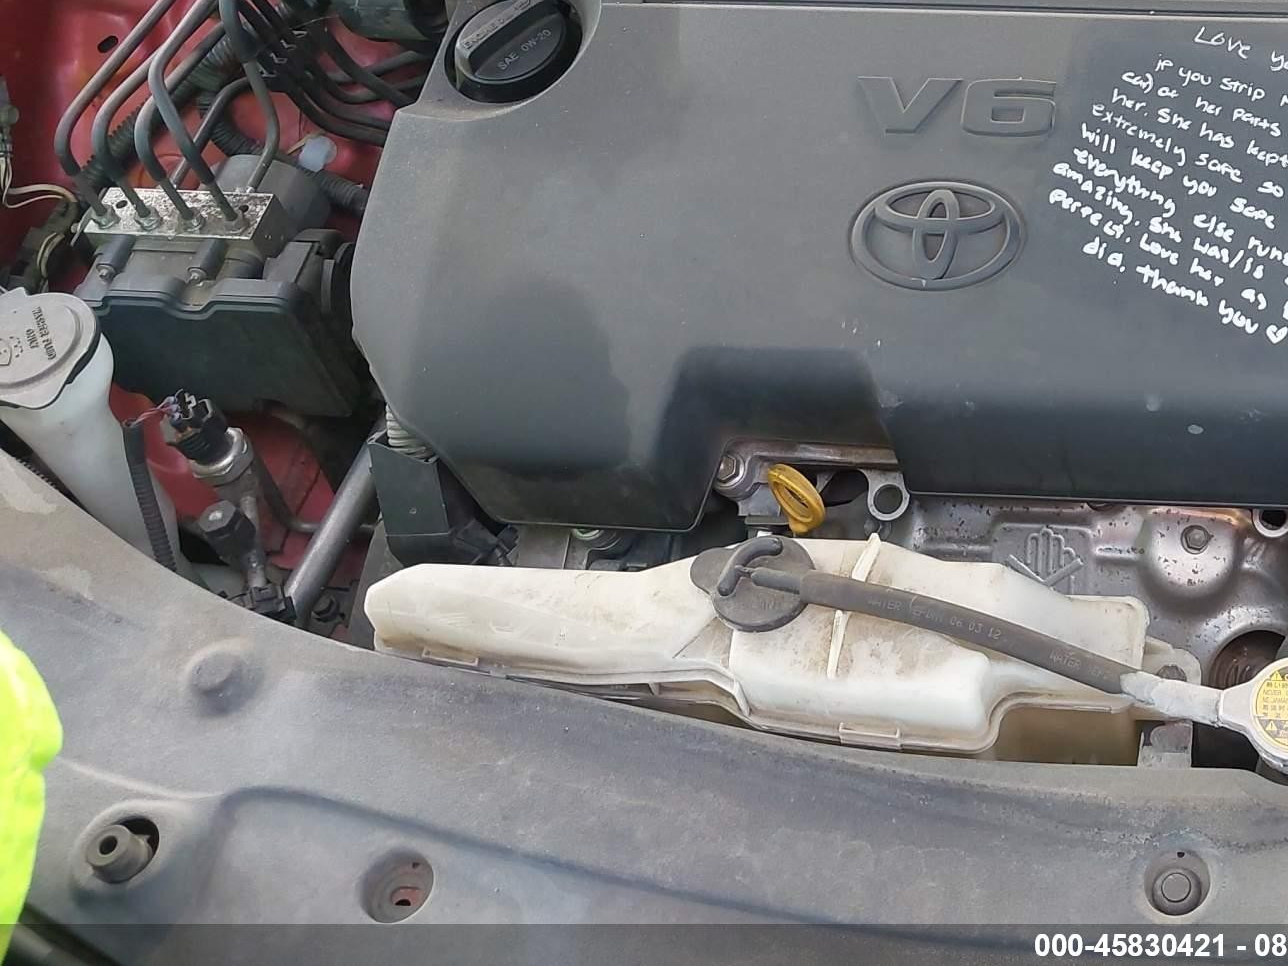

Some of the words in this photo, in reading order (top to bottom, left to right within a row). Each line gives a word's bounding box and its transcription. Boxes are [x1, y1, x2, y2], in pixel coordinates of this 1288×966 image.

[498, 52, 519, 72] SAE
[521, 28, 551, 54] 0W-20
[1178, 66, 1211, 86] you
[857, 76, 1057, 137] V6
[1112, 88, 1148, 118] her.
[1157, 108, 1192, 130] She
[1200, 123, 1235, 149] has
[1121, 71, 1154, 94] car)
[1196, 95, 1221, 117] her
[1232, 108, 1281, 137] parts
[1081, 123, 1116, 154] will
[1131, 148, 1174, 179] keep
[1183, 175, 1216, 197] you
[1092, 103, 1186, 166] extremely
[1195, 154, 1243, 183] safe
[1258, 180, 1284, 198] so
[1053, 162, 1141, 226] amazing.
[1149, 217, 1182, 243] She
[1194, 239, 1264, 280] was/is
[1074, 147, 1176, 217] everything
[1194, 214, 1235, 243] else
[1136, 264, 1209, 306] thank
[1217, 300, 1259, 335] you
[1190, 258, 1224, 286] her
